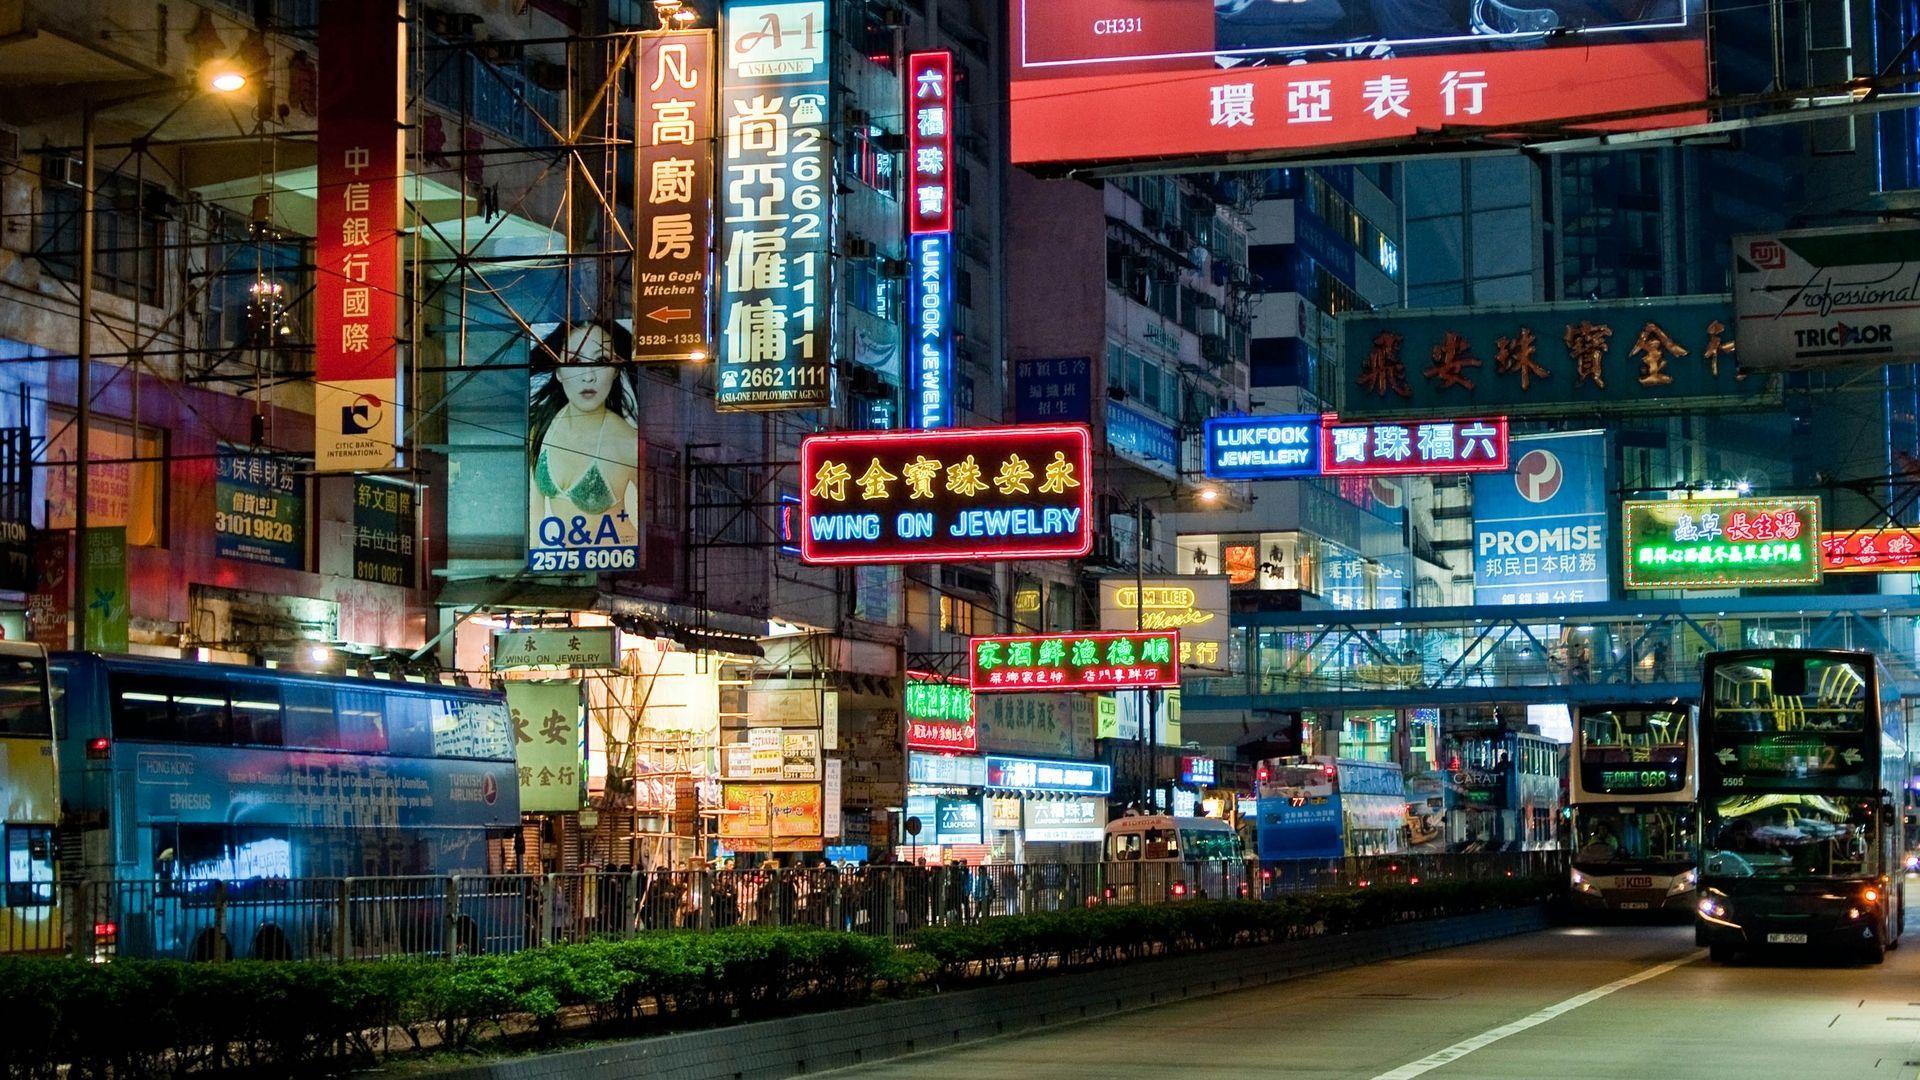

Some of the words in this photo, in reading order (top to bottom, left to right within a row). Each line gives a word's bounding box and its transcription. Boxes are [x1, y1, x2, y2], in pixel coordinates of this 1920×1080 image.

[1094, 17, 1142, 35] CH331
[1209, 70, 1488, 128] 環亞表行
[917, 69, 945, 215] 六福珠寶
[649, 43, 698, 260] 凡高廚房
[791, 127, 821, 240] 2662
[724, 93, 790, 364] 尚亞僱傭
[342, 146, 371, 354] 中信銀行國際
[641, 272, 665, 283] Van
[668, 270, 702, 283] Gogh
[643, 285, 695, 297] Kitchen
[921, 239, 940, 338] LUKFOOK
[792, 252, 815, 359] 1111
[638, 333, 701, 346] 3528-1333
[740, 366, 784, 388] 2662
[787, 365, 825, 386] 1111
[720, 390, 750, 403] ASIA-ONE
[751, 389, 798, 402] EMPLOYMENT
[798, 388, 826, 400] AGENCY
[921, 343, 940, 432] JEWELL
[335, 442, 353, 450] CITIC
[355, 441, 375, 449] BANK
[1217, 427, 1308, 446] LUKFOOK
[327, 449, 383, 458] INTERNATIONAL
[1217, 449, 1309, 467] JEWELLERY
[0, 522, 26, 541] TION
[215, 511, 251, 536] 3101
[253, 518, 293, 543] 9828
[810, 512, 880, 541] WING
[897, 511, 933, 538] ON
[950, 506, 1081, 537] JEWELRY
[1479, 525, 1602, 556] PROMISE
[532, 550, 579, 571] 2575
[584, 548, 635, 569] 6006
[1485, 553, 1597, 578] 邦民日本財務
[357, 561, 379, 579] 8101
[1162, 590, 1188, 604] LEE
[523, 635, 581, 653] 永安
[506, 655, 531, 665] WING
[536, 654, 550, 664] ON
[556, 652, 600, 664] JEWELRY
[147, 760, 171, 774] HONG
[171, 761, 194, 775] KONG
[450, 773, 481, 786] TURKISH
[1453, 773, 1499, 784] CARAT
[1641, 771, 1667, 787] 968
[1723, 778, 1744, 787] 5505
[170, 793, 211, 810] EPHESUS
[450, 788, 483, 802] AIRLINES
[1292, 797, 1305, 807] 77
[942, 803, 977, 822] 六福
[1034, 802, 1096, 819] 六福珠寶
